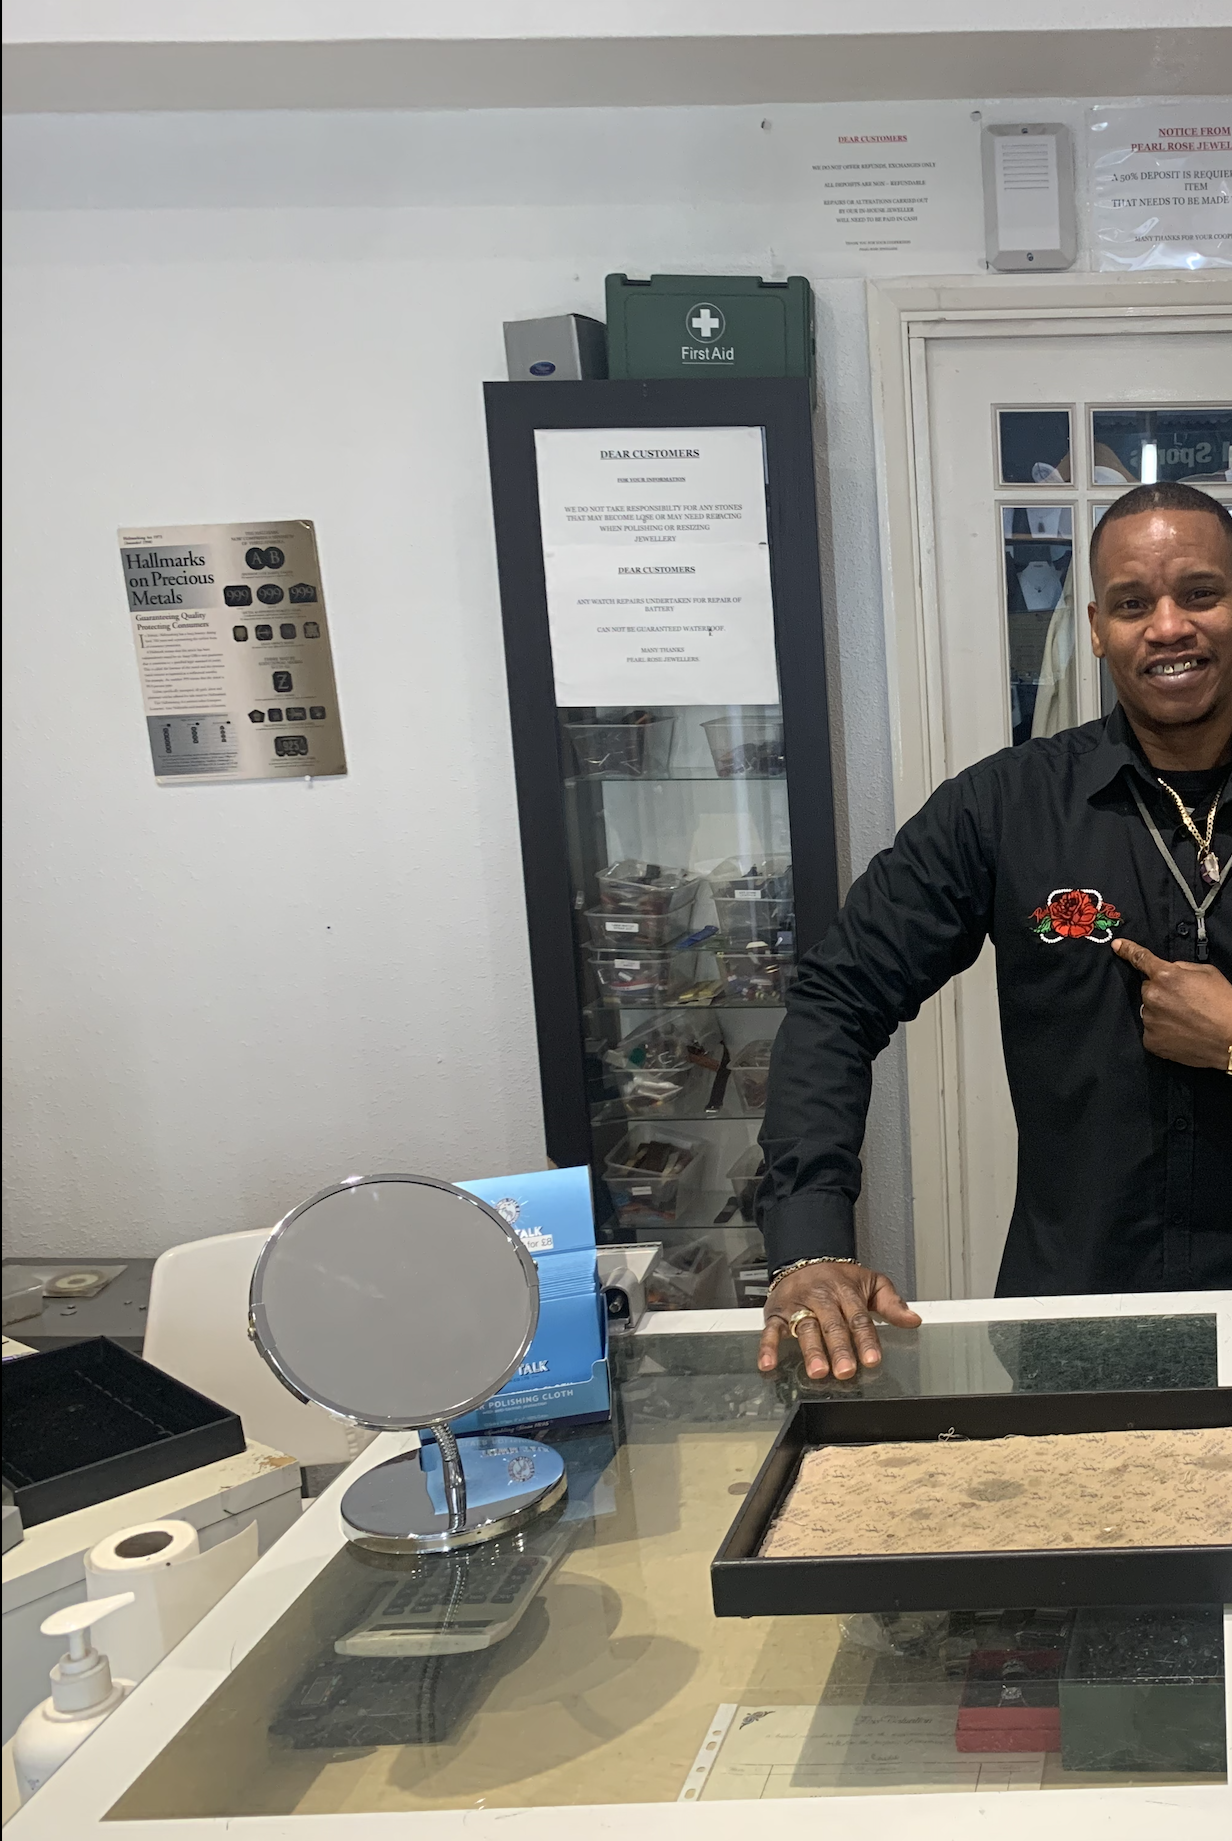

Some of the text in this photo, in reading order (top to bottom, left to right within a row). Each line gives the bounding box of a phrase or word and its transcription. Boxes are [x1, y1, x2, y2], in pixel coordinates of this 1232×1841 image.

[1158, 127, 1231, 138] NOTICE FROM
[838, 135, 907, 143] DEAR CUSTOMERS
[1131, 143, 1165, 153] PEARL
[1167, 142, 1195, 152] ROSE
[1111, 173, 1118, 181] A
[1119, 172, 1139, 183] 50%
[1140, 170, 1180, 180] DEPOSIT
[1182, 170, 1191, 179] IS
[1184, 182, 1208, 191] ITEM
[1111, 199, 1137, 208] THAT
[1138, 197, 1170, 207] NEEDS
[1171, 196, 1185, 205] TO
[1187, 196, 1200, 205] BE
[1201, 194, 1230, 205] MADE
[680, 345, 736, 362] First Aid
[600, 449, 699, 460] DEAR CUSTOMERS
[626, 504, 682, 512] RESPONSIBILTY
[125, 550, 205, 569] Hallmarks
[641, 566, 695, 574] CUSTOMERS
[129, 570, 214, 587] on Precious
[132, 589, 183, 605] Metals
[135, 611, 206, 623] Guaranteeing Quality
[137, 621, 209, 632] Protecting Consumers
[515, 1226, 543, 1238] TALK
[528, 1237, 553, 1248] for £8
[517, 1360, 550, 1375] TALK
[489, 1389, 573, 1408] POLISHING CLOTH
